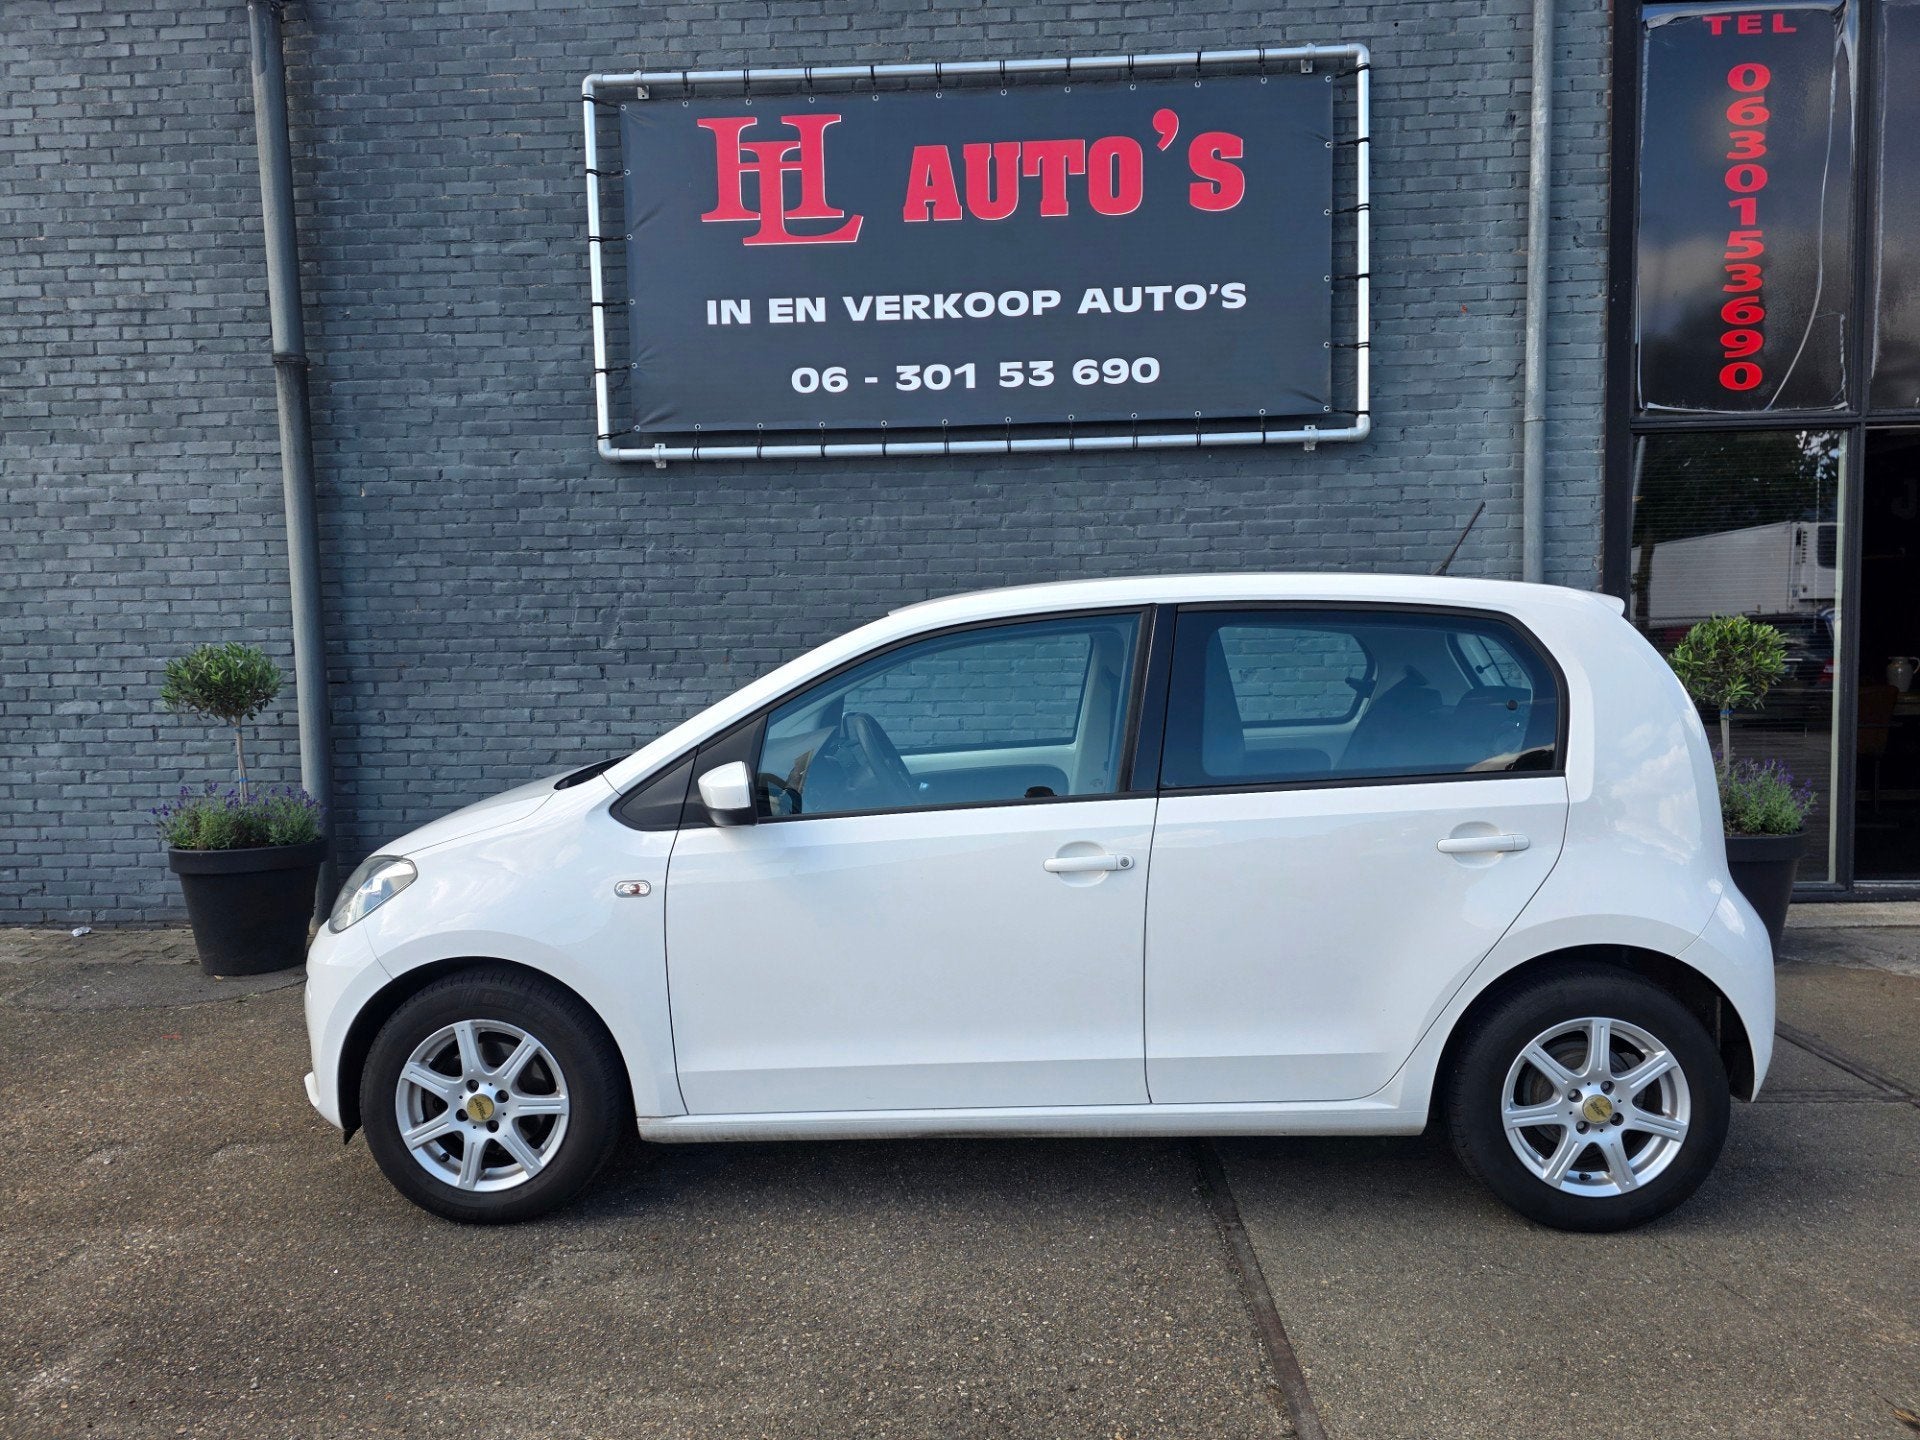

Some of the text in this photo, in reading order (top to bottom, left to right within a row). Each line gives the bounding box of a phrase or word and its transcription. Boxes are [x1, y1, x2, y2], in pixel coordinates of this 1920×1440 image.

[1702, 13, 1797, 36] TEL
[696, 108, 1246, 246] HL AUTO'S
[1718, 62, 1772, 392] 0630153690
[706, 282, 1248, 326] IN EN VERKOOP AUTO'S
[791, 356, 1161, 394] 06 - 301 53 690
